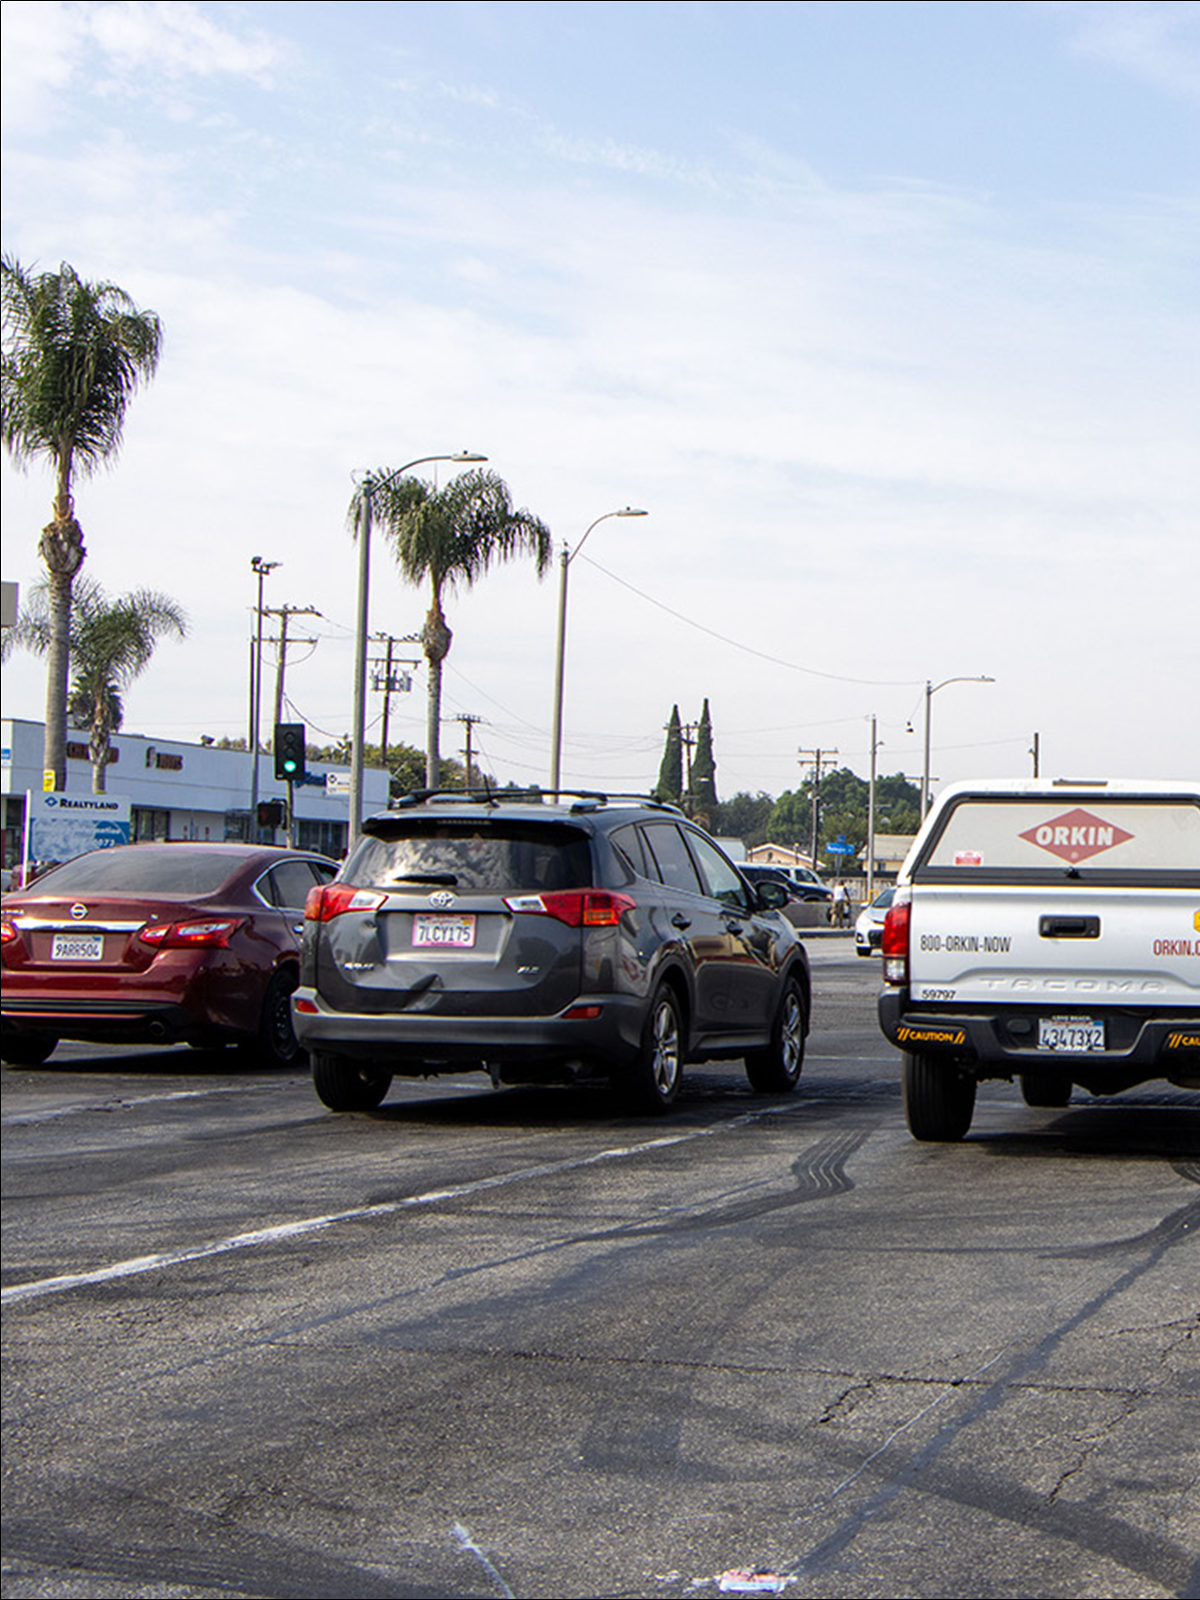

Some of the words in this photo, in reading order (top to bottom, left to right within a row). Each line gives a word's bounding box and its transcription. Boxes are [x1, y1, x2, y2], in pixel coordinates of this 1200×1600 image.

[1035, 826, 1114, 846] ORKIN
[419, 925, 472, 942] 7LCY175
[920, 934, 1012, 953] 800-ORKIN-NOW
[980, 978, 1168, 993] TACOMA
[921, 989, 956, 1000] 59797
[909, 1031, 953, 1041] CAUTION
